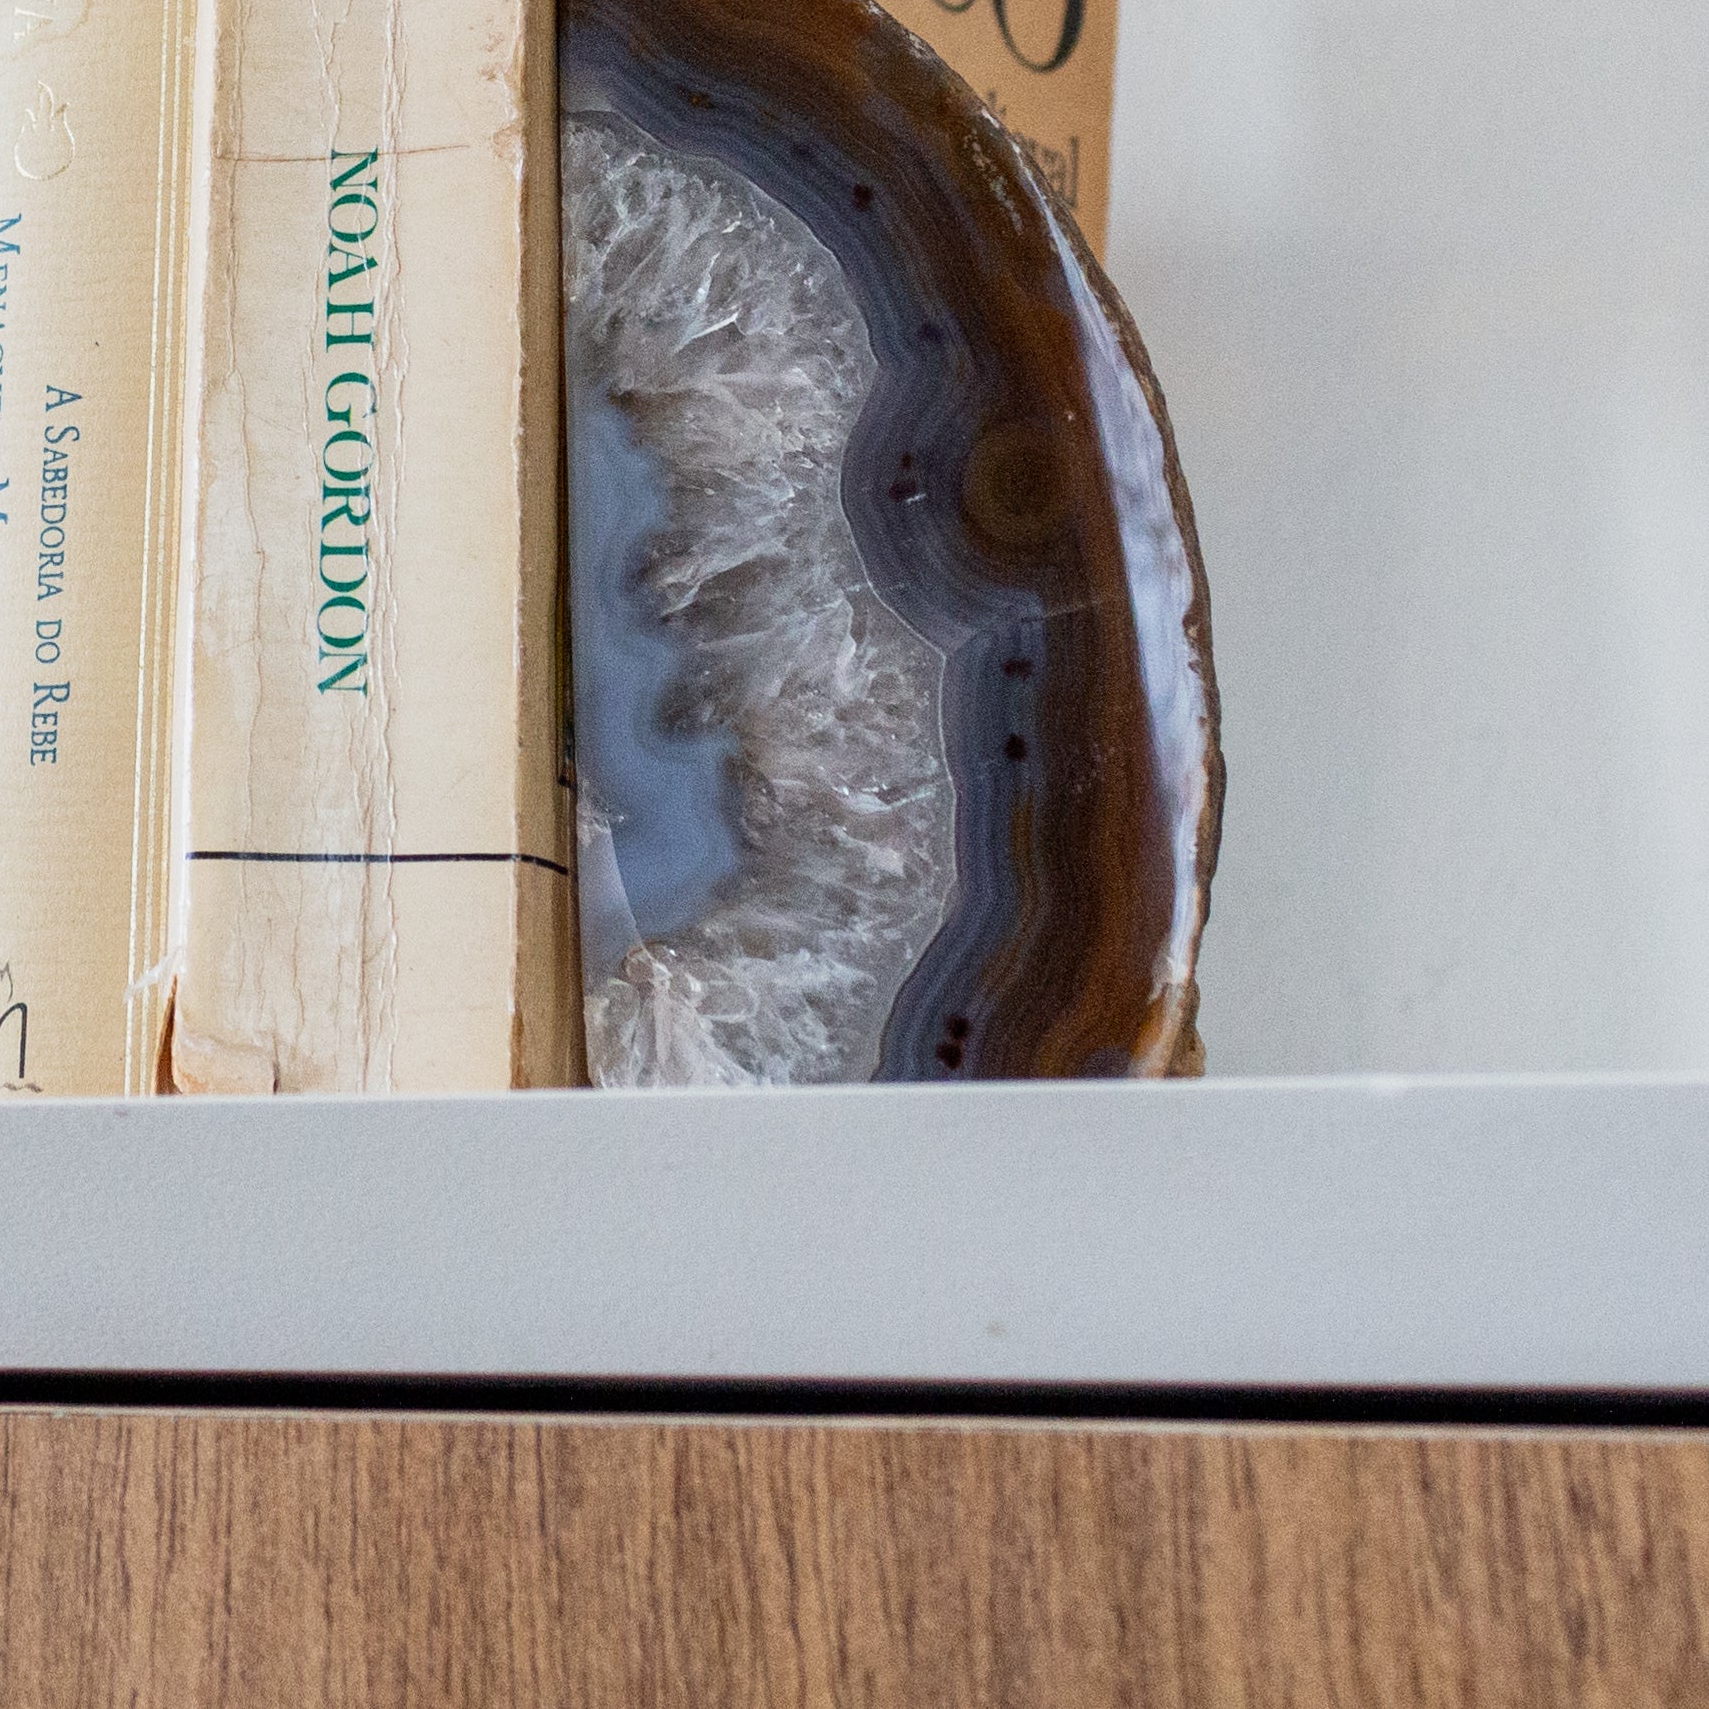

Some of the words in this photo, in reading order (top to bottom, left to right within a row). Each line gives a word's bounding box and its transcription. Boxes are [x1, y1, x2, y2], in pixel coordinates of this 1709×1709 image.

[325, 148, 380, 349] NOAH
[45, 384, 83, 412] A
[36, 425, 81, 602] SABEDORIA
[317, 371, 378, 697] GORDON
[34, 618, 63, 665] DO
[29, 680, 71, 766] REBE
